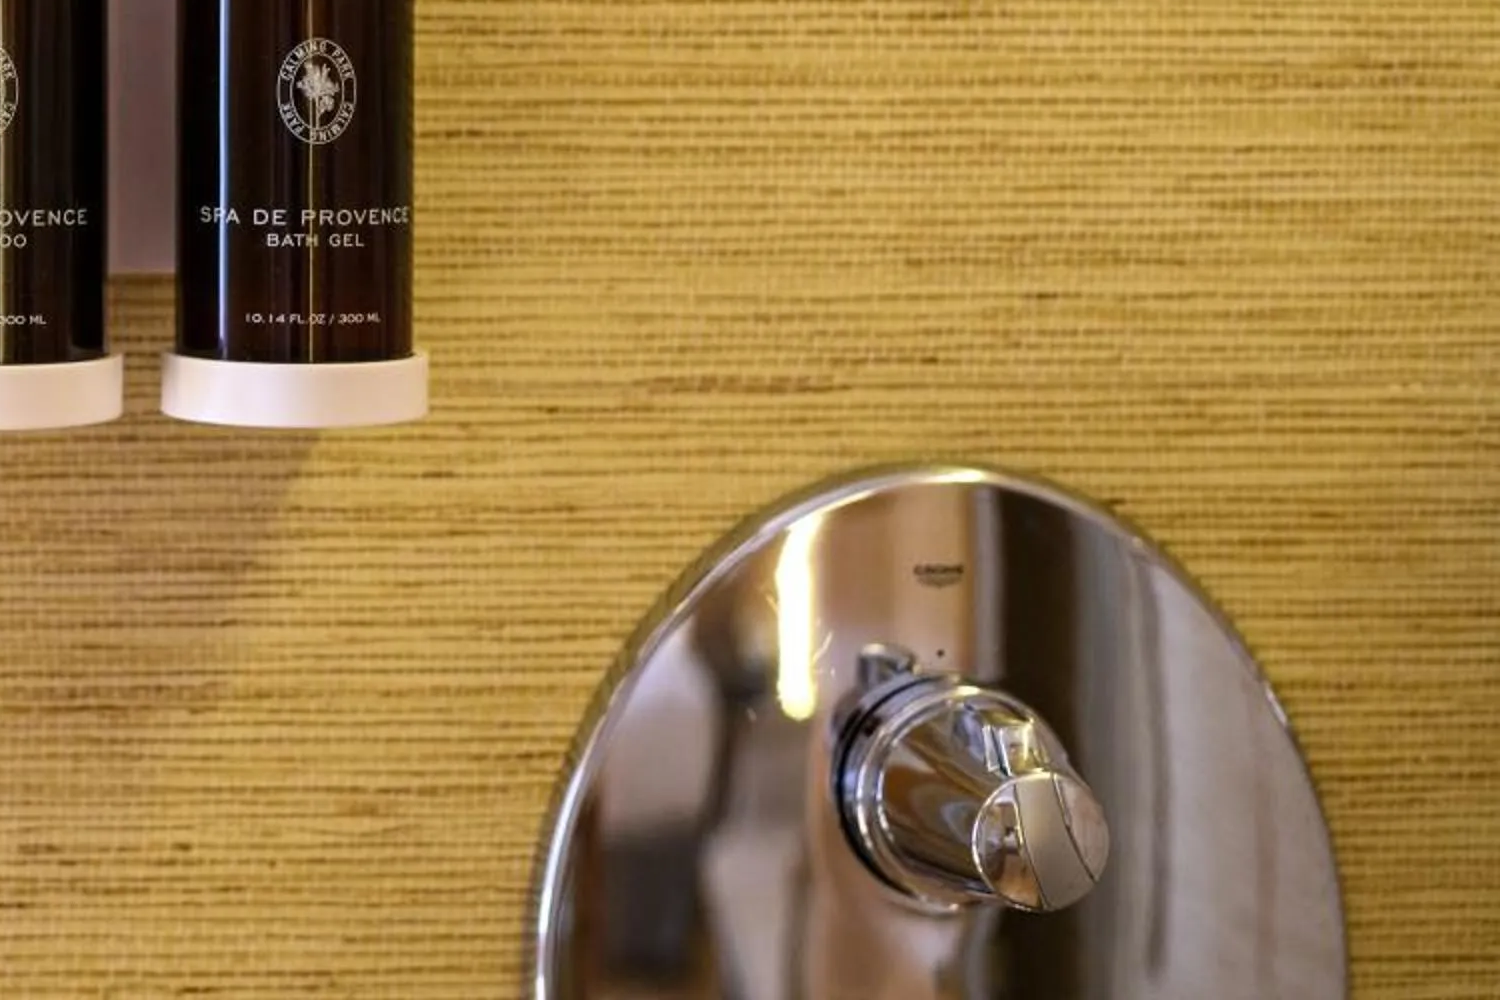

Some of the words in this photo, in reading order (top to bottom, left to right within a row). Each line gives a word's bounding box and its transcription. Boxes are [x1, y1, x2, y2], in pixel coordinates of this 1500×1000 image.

[281, 40, 327, 80] CALMING
[200, 206, 241, 223] SPA
[253, 209, 288, 226] DE
[301, 206, 410, 226] PROVENCE
[266, 233, 319, 247] BATH
[329, 233, 365, 247] GEL
[29, 315, 47, 325] ML
[339, 313, 365, 325] 300
[367, 311, 381, 323] ML
